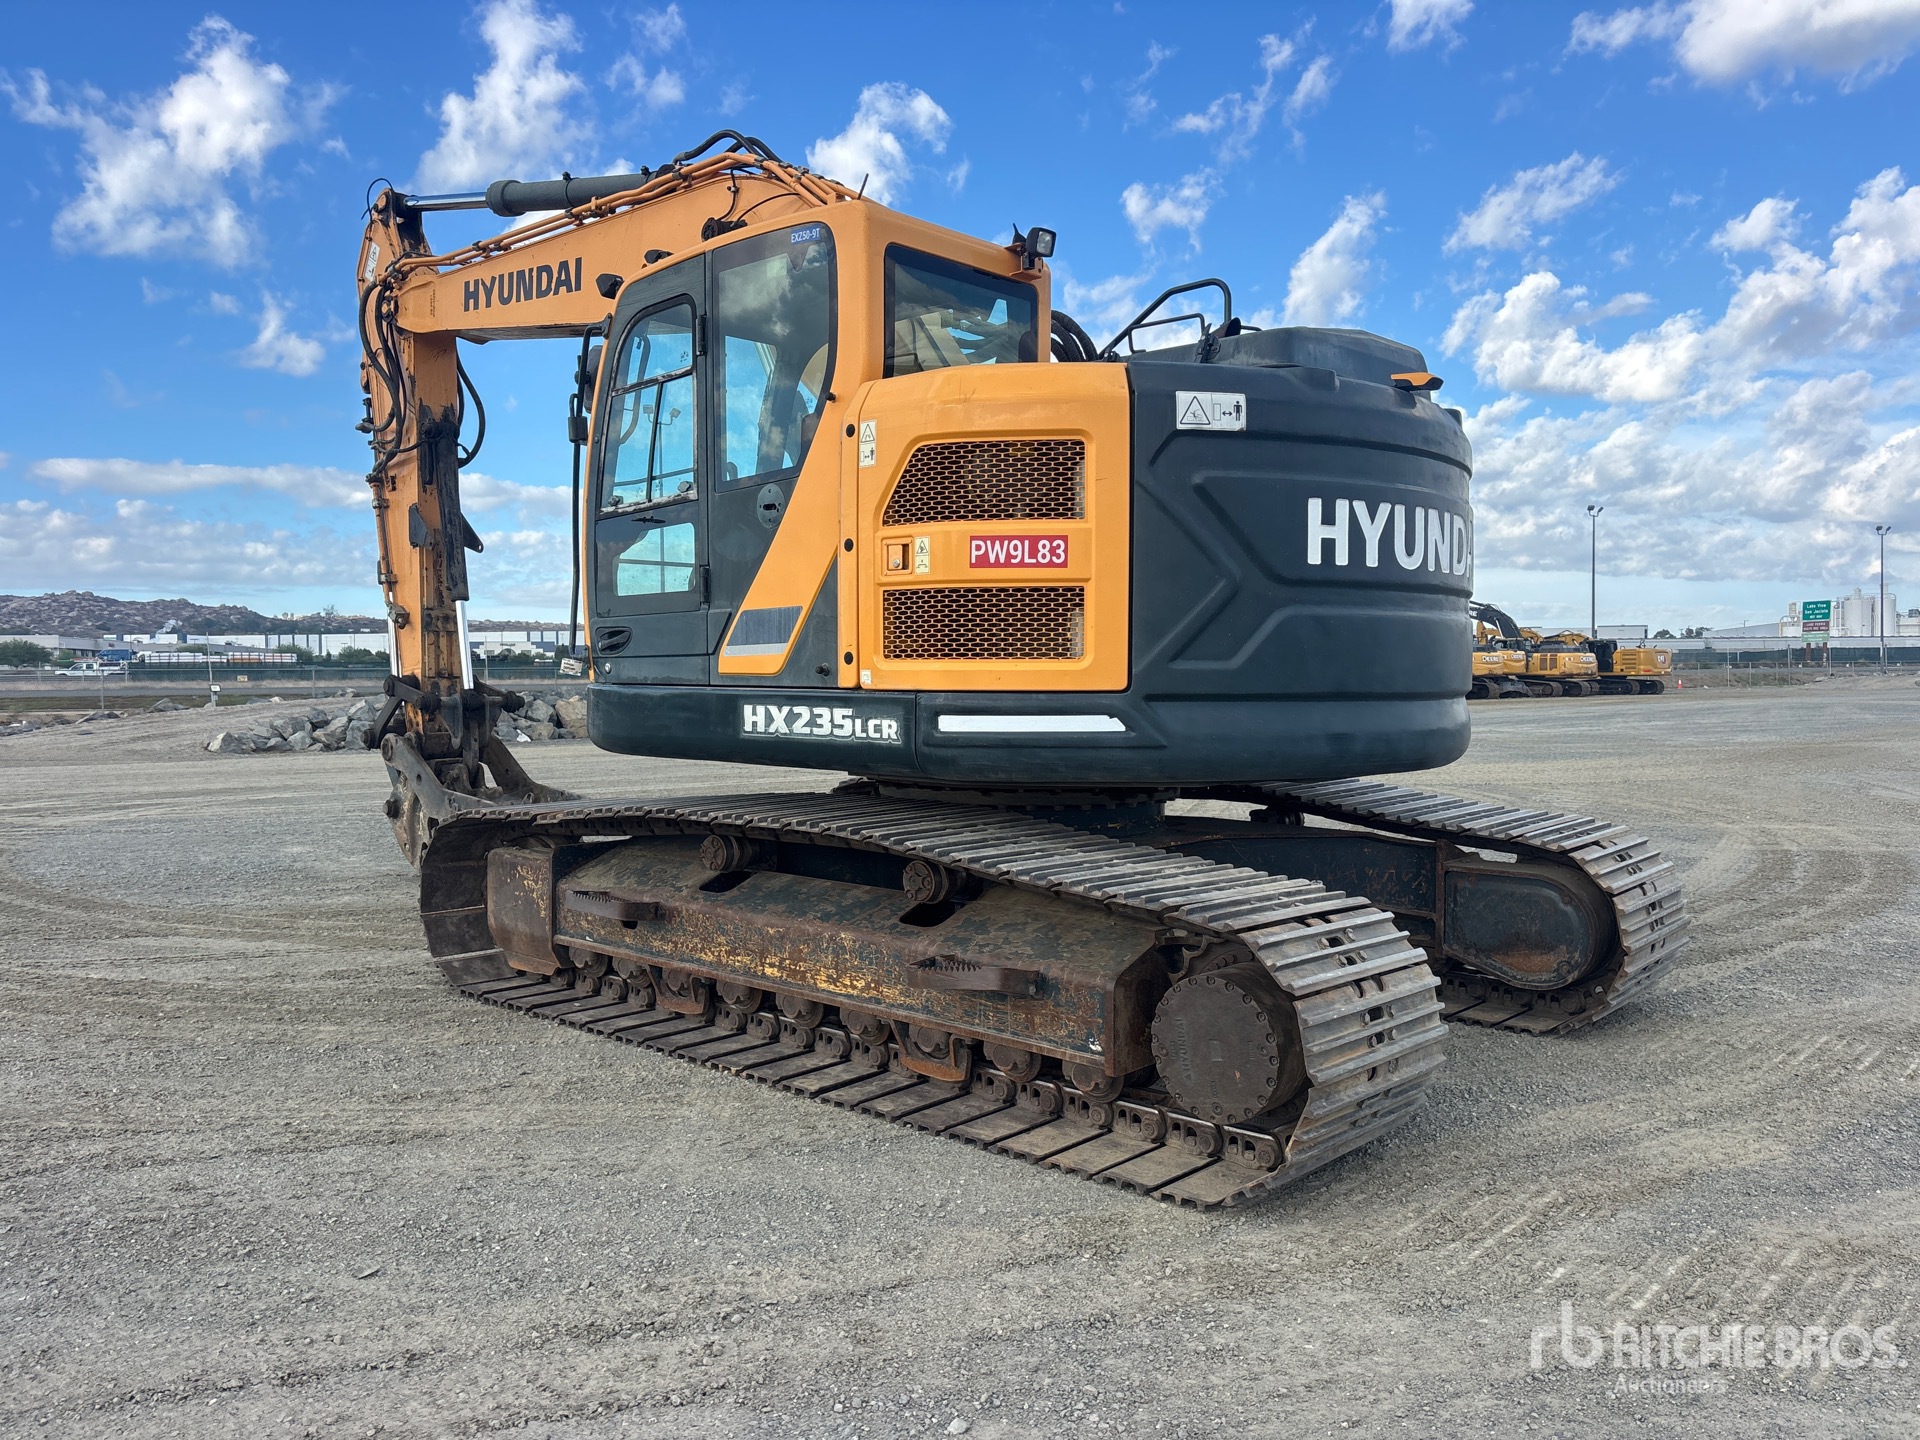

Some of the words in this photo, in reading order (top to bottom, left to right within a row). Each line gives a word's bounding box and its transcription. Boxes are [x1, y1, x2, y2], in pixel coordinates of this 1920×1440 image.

[463, 257, 582, 312] HYUNDAI
[971, 539, 1066, 564] PW9L83
[1307, 497, 1473, 578] HYUNDA
